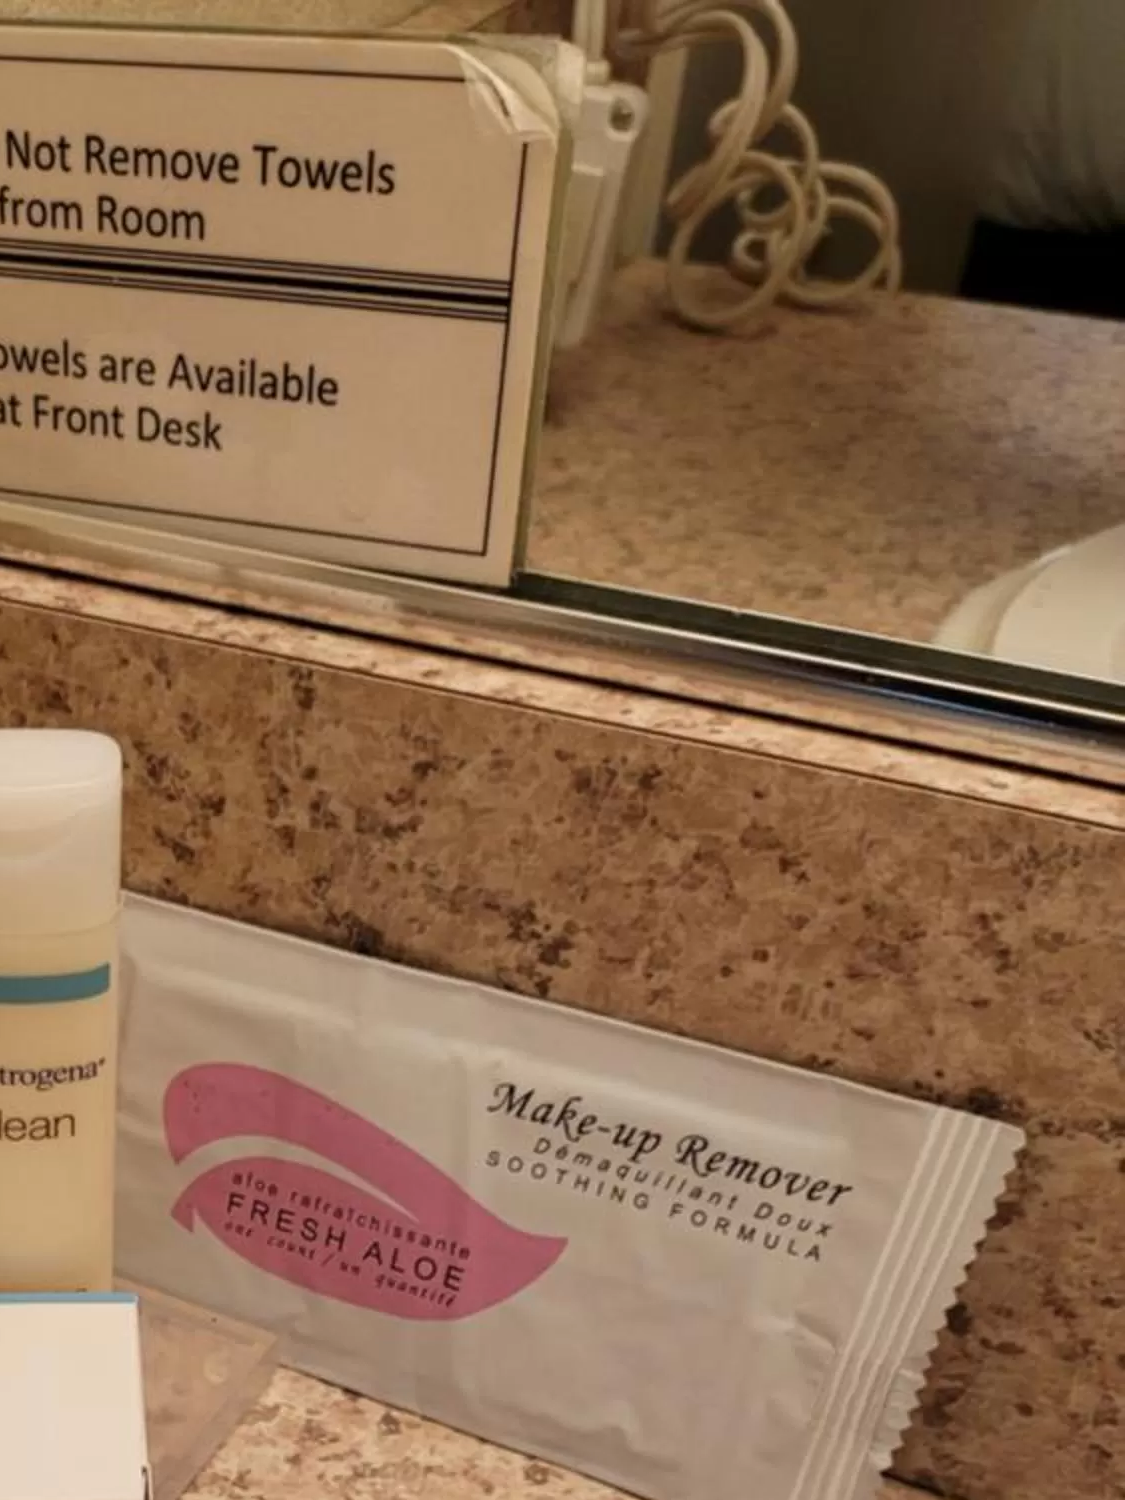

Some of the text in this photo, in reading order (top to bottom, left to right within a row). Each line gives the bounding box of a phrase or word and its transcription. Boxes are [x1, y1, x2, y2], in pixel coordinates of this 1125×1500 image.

[6, 129, 71, 173] Not
[85, 136, 240, 185] Remove
[254, 145, 396, 197] Towels
[98, 196, 207, 241] Room
[99, 353, 157, 387] are
[169, 354, 340, 406] Available
[34, 396, 125, 440] Front
[138, 407, 223, 451] Desk
[486, 1083, 853, 1207] Make-up Remover
[232, 1171, 279, 1197] aloe
[486, 1150, 822, 1262] SOOTHING FORMULA
[533, 1138, 833, 1238] Démaquillant Doux
[226, 1193, 465, 1292] FRESH ALOE
